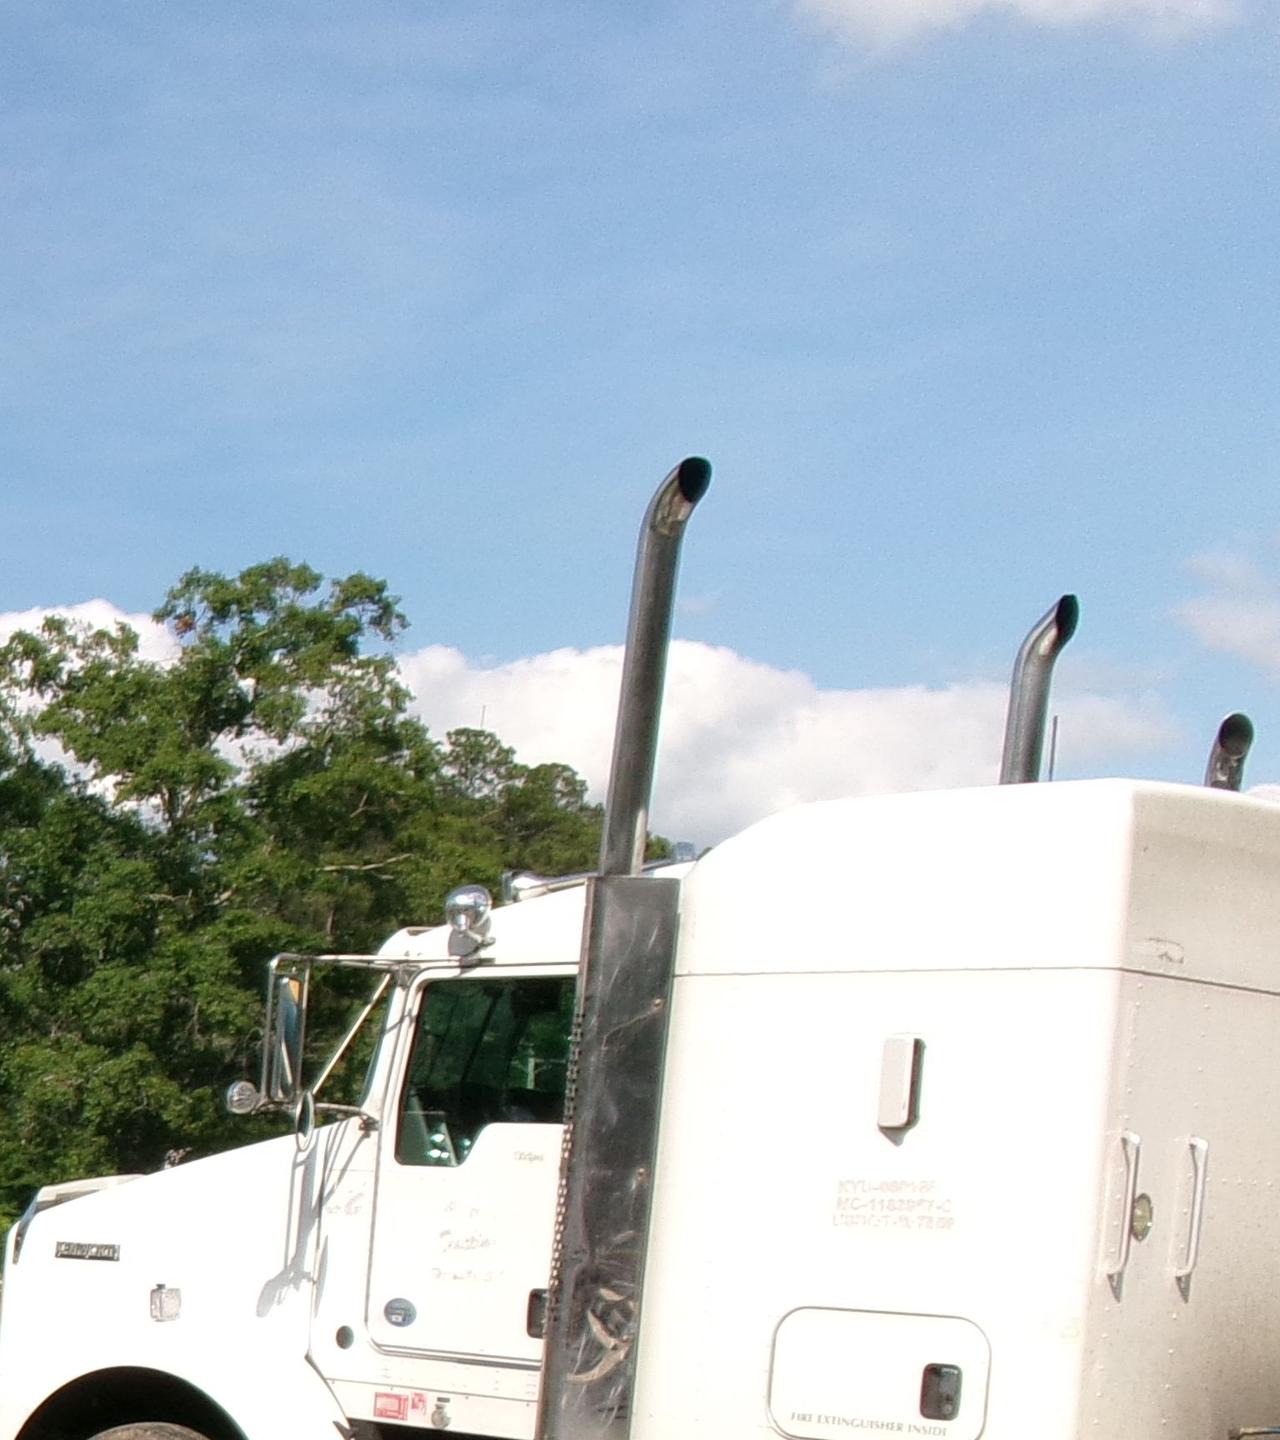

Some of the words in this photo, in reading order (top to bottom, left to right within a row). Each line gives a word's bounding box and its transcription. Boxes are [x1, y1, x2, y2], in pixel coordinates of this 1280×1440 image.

[791, 1411, 813, 1423] FIRE
[817, 1414, 904, 1433] EXTINGUISHER
[908, 1423, 948, 1437] INSIDE
